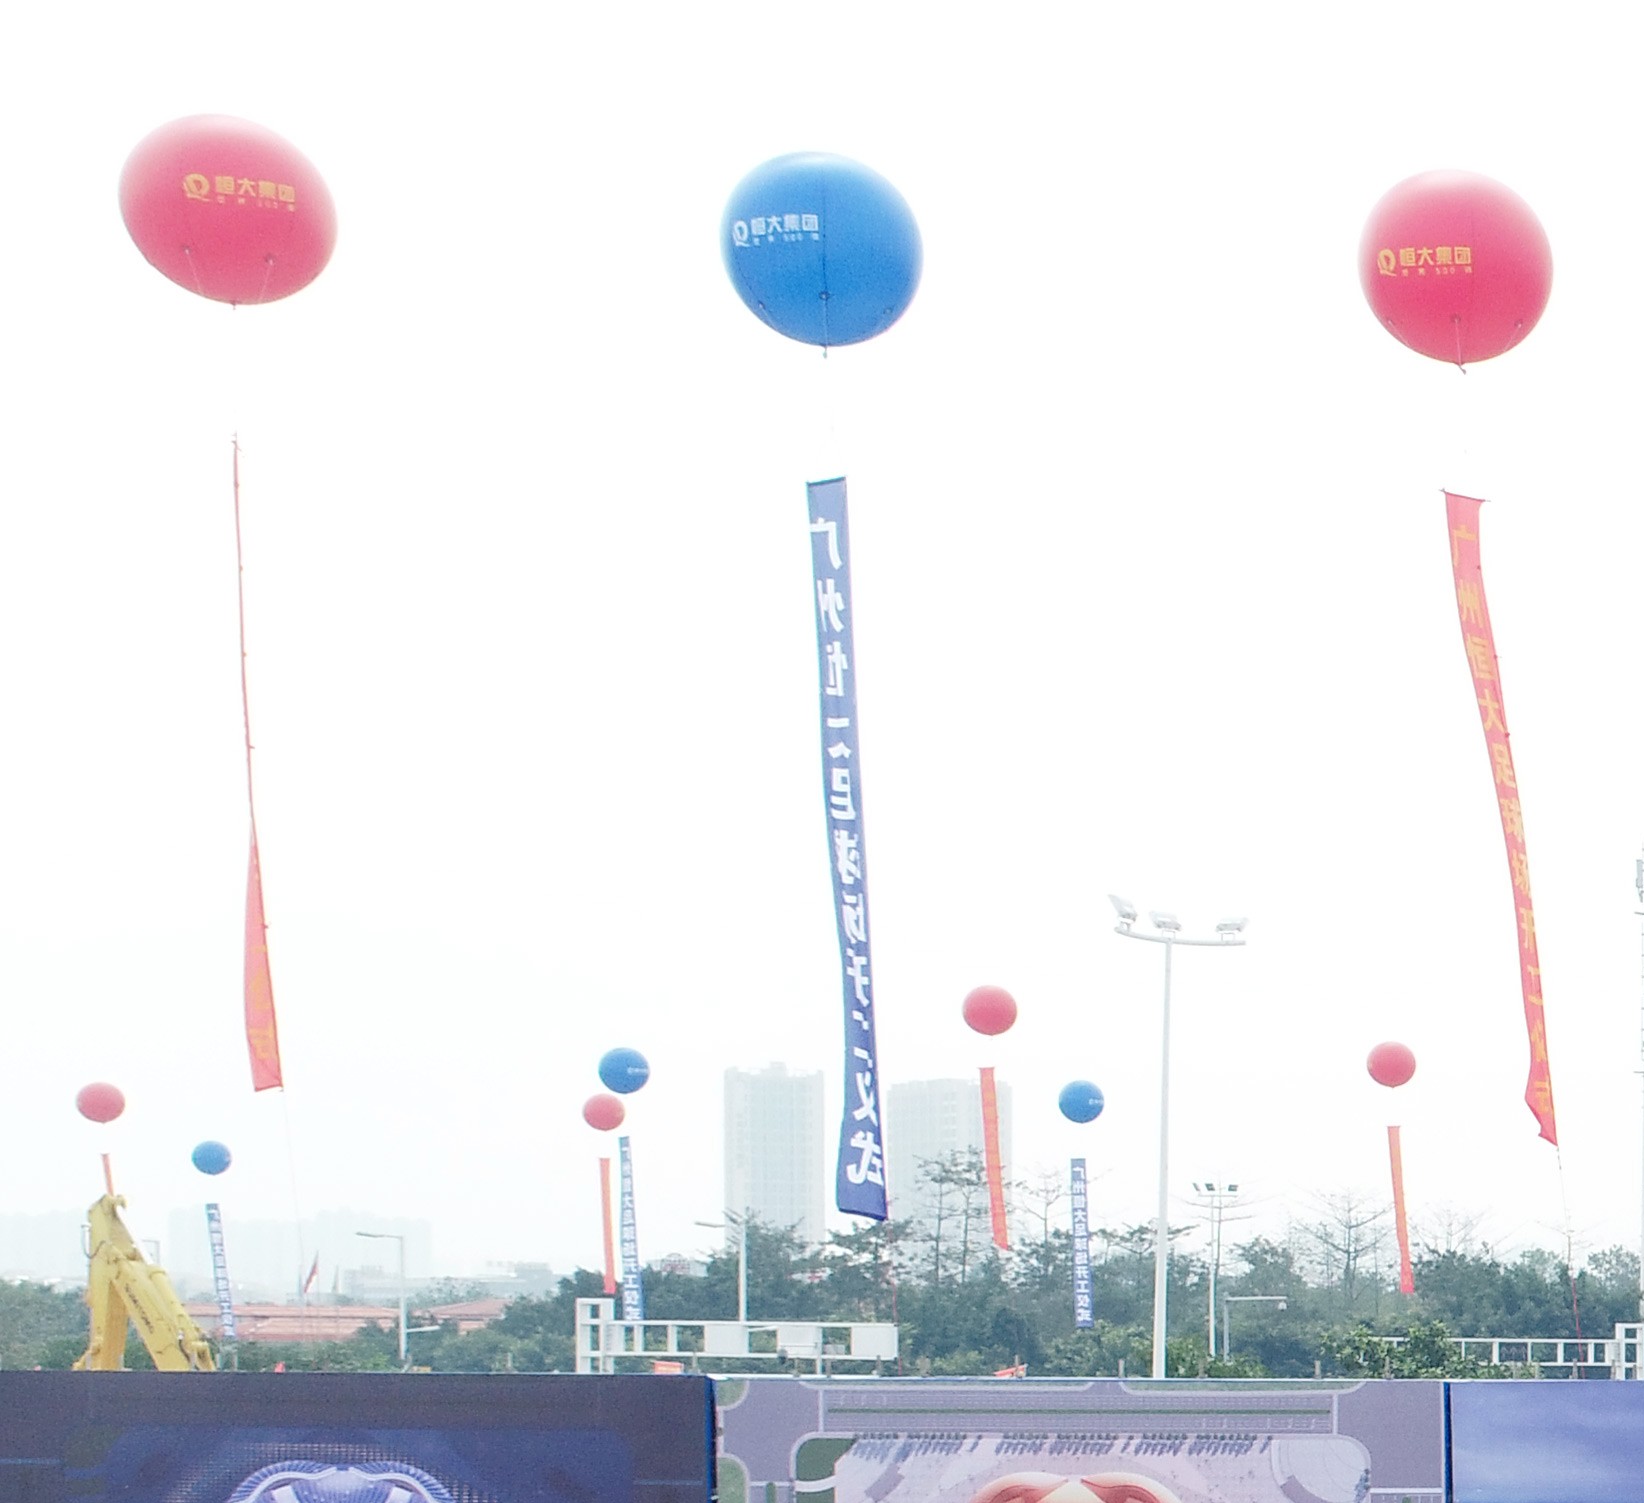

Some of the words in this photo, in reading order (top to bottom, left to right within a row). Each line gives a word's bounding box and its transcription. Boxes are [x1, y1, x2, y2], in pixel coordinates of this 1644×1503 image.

[215, 175, 296, 203] 恒大集团
[750, 213, 819, 237] 恒大集团
[1400, 246, 1472, 267] 恒大集团
